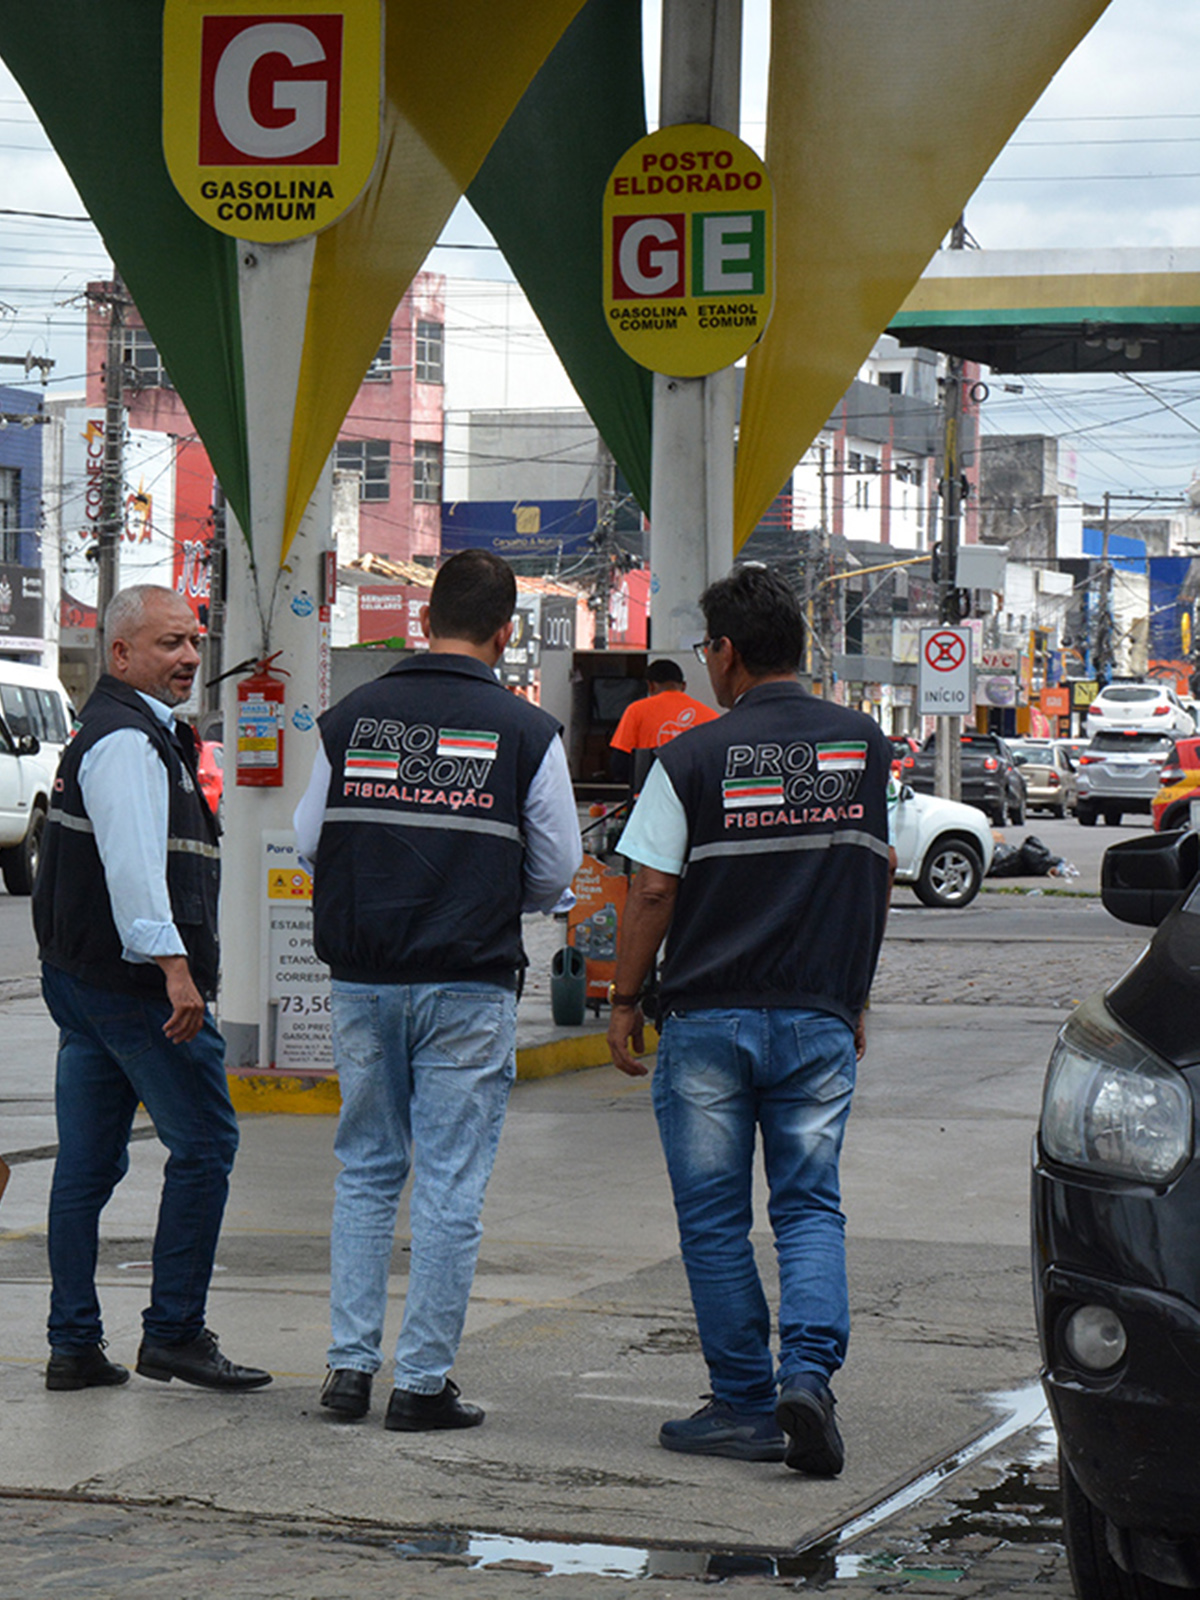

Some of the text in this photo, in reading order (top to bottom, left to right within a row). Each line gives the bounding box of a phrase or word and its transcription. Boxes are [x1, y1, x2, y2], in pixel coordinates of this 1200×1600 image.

[214, 22, 327, 158] G
[642, 151, 733, 172] POSTO
[201, 181, 335, 199] GASOLINA
[614, 172, 762, 195] ELDORADO
[217, 203, 316, 221] COMUM
[619, 215, 753, 295] G E
[610, 306, 688, 319] GASOLINA
[698, 304, 758, 316] ETANOL
[620, 319, 677, 331] COMUM
[698, 316, 757, 328] COMUM
[924, 687, 965, 703] INÍCIO
[349, 717, 436, 753] PRO
[725, 741, 813, 777] PRO
[400, 753, 493, 788] CON
[343, 782, 494, 810] FISCALIZAÇÃO
[724, 803, 864, 829] FISCALIZAO
[266, 843, 294, 853] Para
[288, 938, 298, 947] O
[292, 1023, 305, 1031] DO
[282, 1032, 326, 1041] GASOLINA
